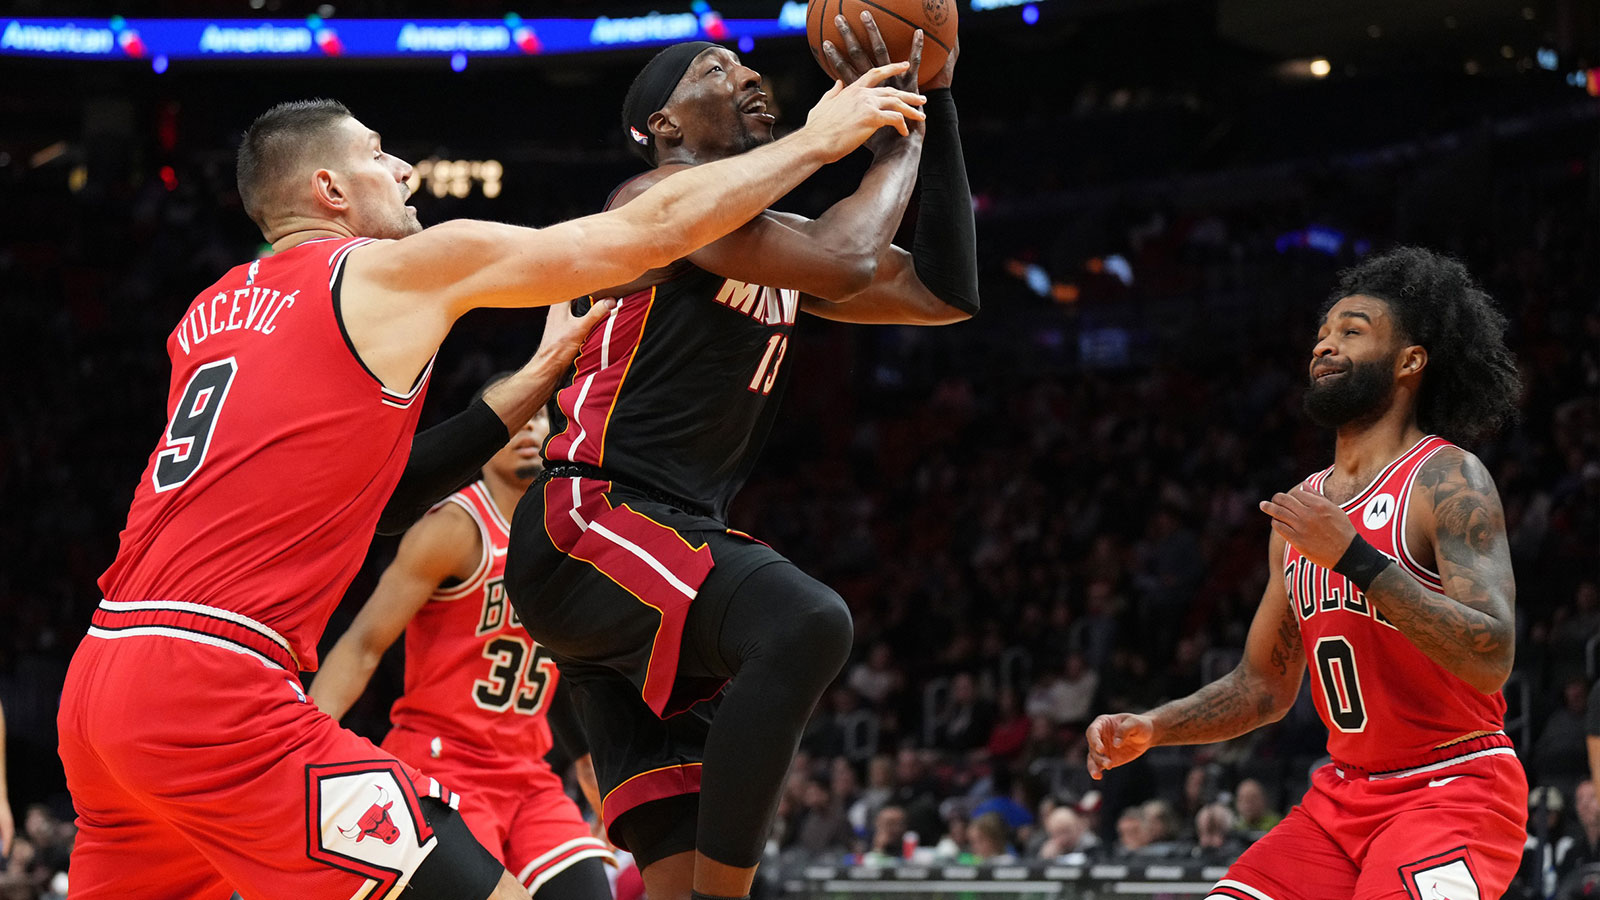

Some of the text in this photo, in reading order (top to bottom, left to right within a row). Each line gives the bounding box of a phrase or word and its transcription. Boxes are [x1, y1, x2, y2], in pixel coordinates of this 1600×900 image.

[747, 332, 789, 396] 13
[152, 355, 239, 494] 9
[1285, 550, 1400, 631] ULL
[471, 634, 553, 716] 35
[1313, 635, 1368, 733] 0
